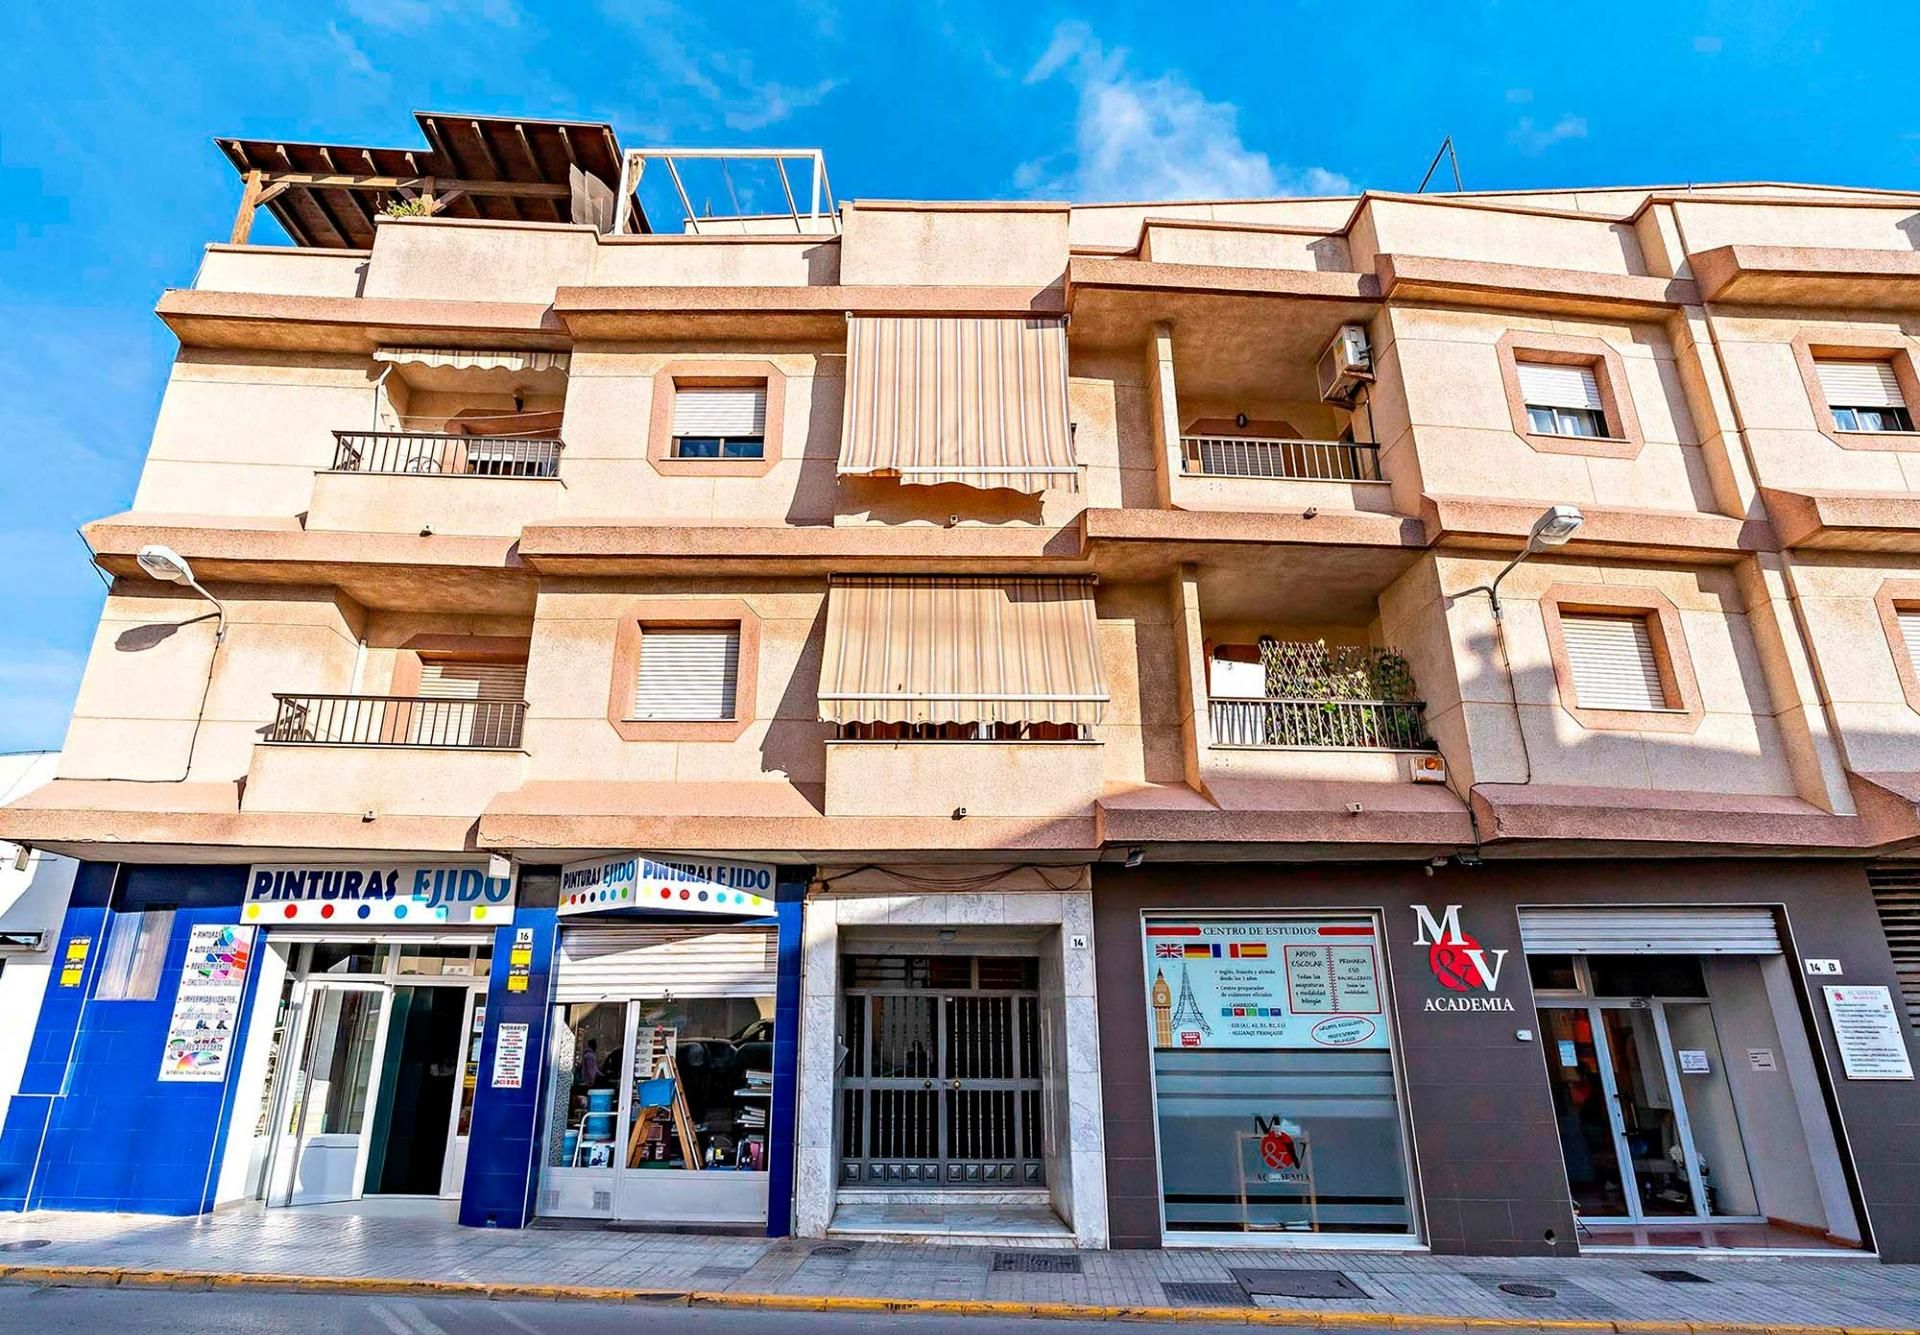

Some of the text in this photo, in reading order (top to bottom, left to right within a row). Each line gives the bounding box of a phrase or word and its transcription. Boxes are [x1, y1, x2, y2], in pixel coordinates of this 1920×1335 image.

[563, 860, 636, 889] PINTURAS EJIDO
[643, 859, 712, 884] PINTURAS
[252, 870, 511, 908] PINTURAS EJIDO
[520, 932, 529, 941] 16
[1203, 926, 1317, 936] CENTRO DE ESTUDIOS
[1073, 938, 1084, 947] 14
[1810, 963, 1836, 971] 14 B
[1424, 997, 1515, 1012] ACADEMIA
